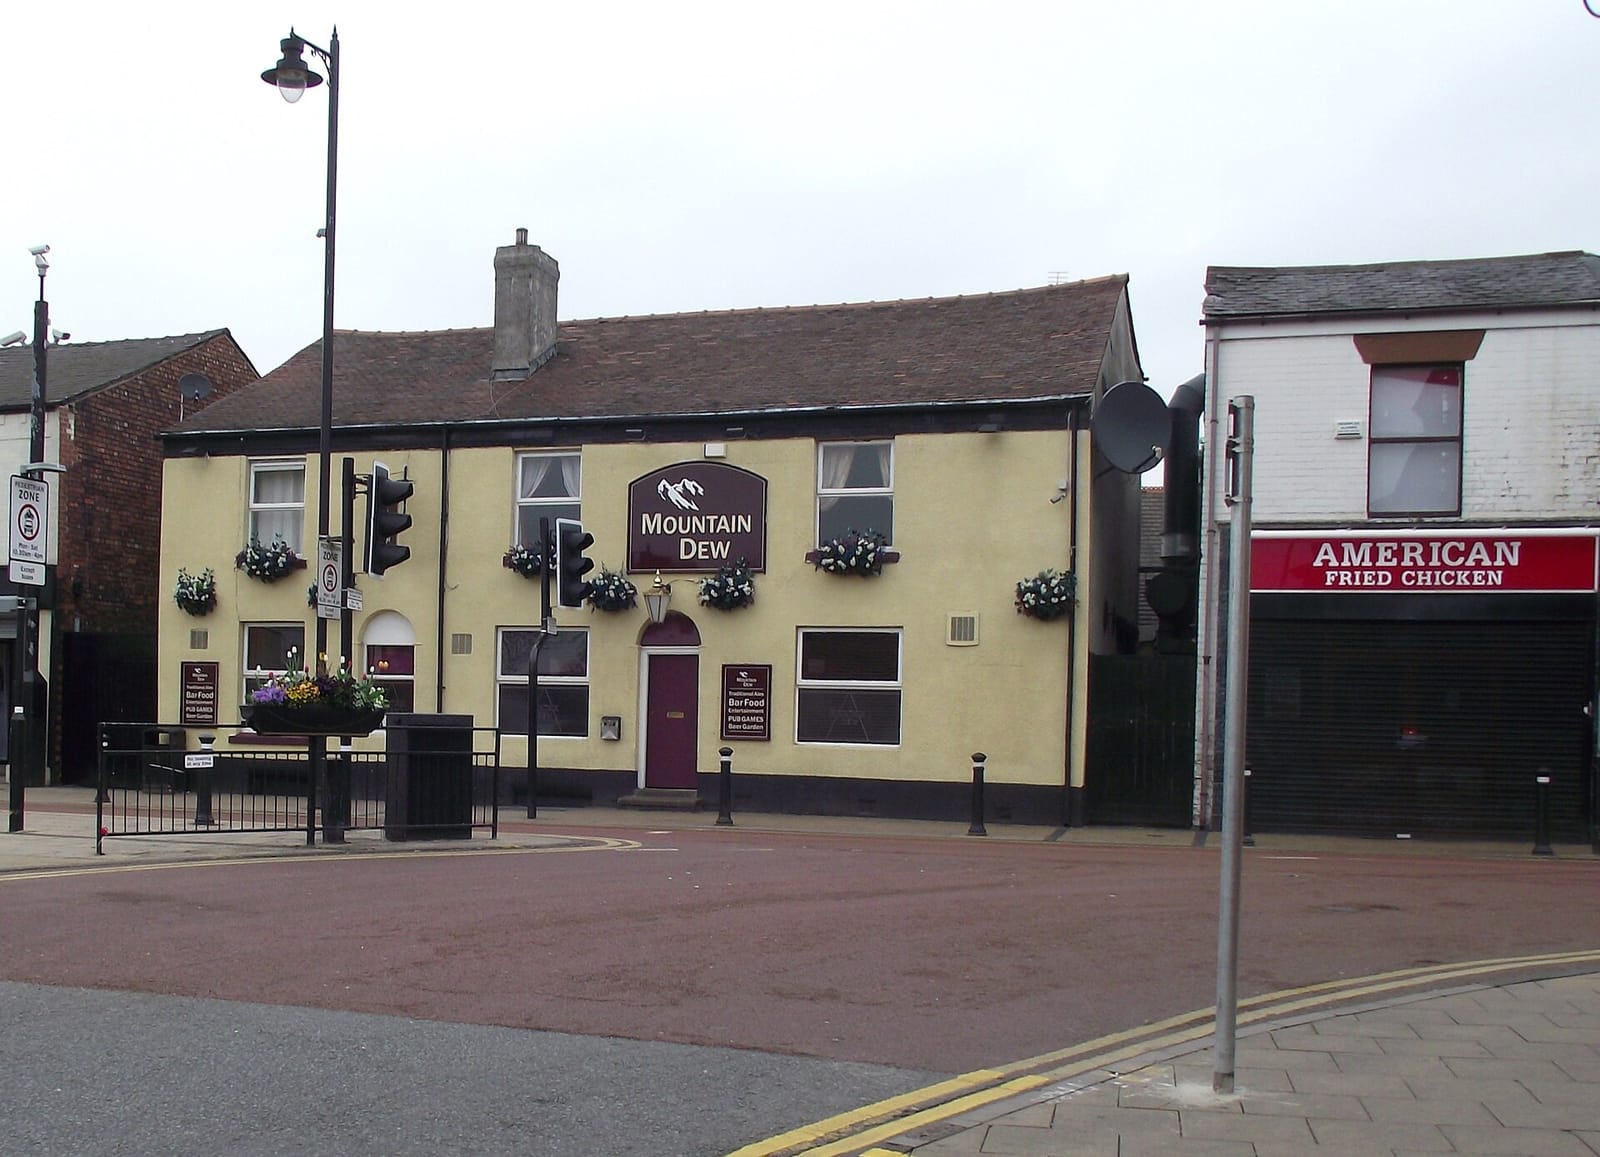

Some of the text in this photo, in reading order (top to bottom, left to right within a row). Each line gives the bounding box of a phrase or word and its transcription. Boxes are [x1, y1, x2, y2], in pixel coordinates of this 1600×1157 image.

[18, 489, 40, 502] ZONE
[641, 513, 752, 535] MOUNTAIN
[679, 537, 731, 560] DEW
[1312, 541, 1522, 567] AMERICAN
[323, 552, 338, 562] ZONE
[1324, 570, 1504, 586] FRIED CHICKEN
[186, 691, 214, 699] Bar Food
[728, 698, 765, 707] Bar Food
